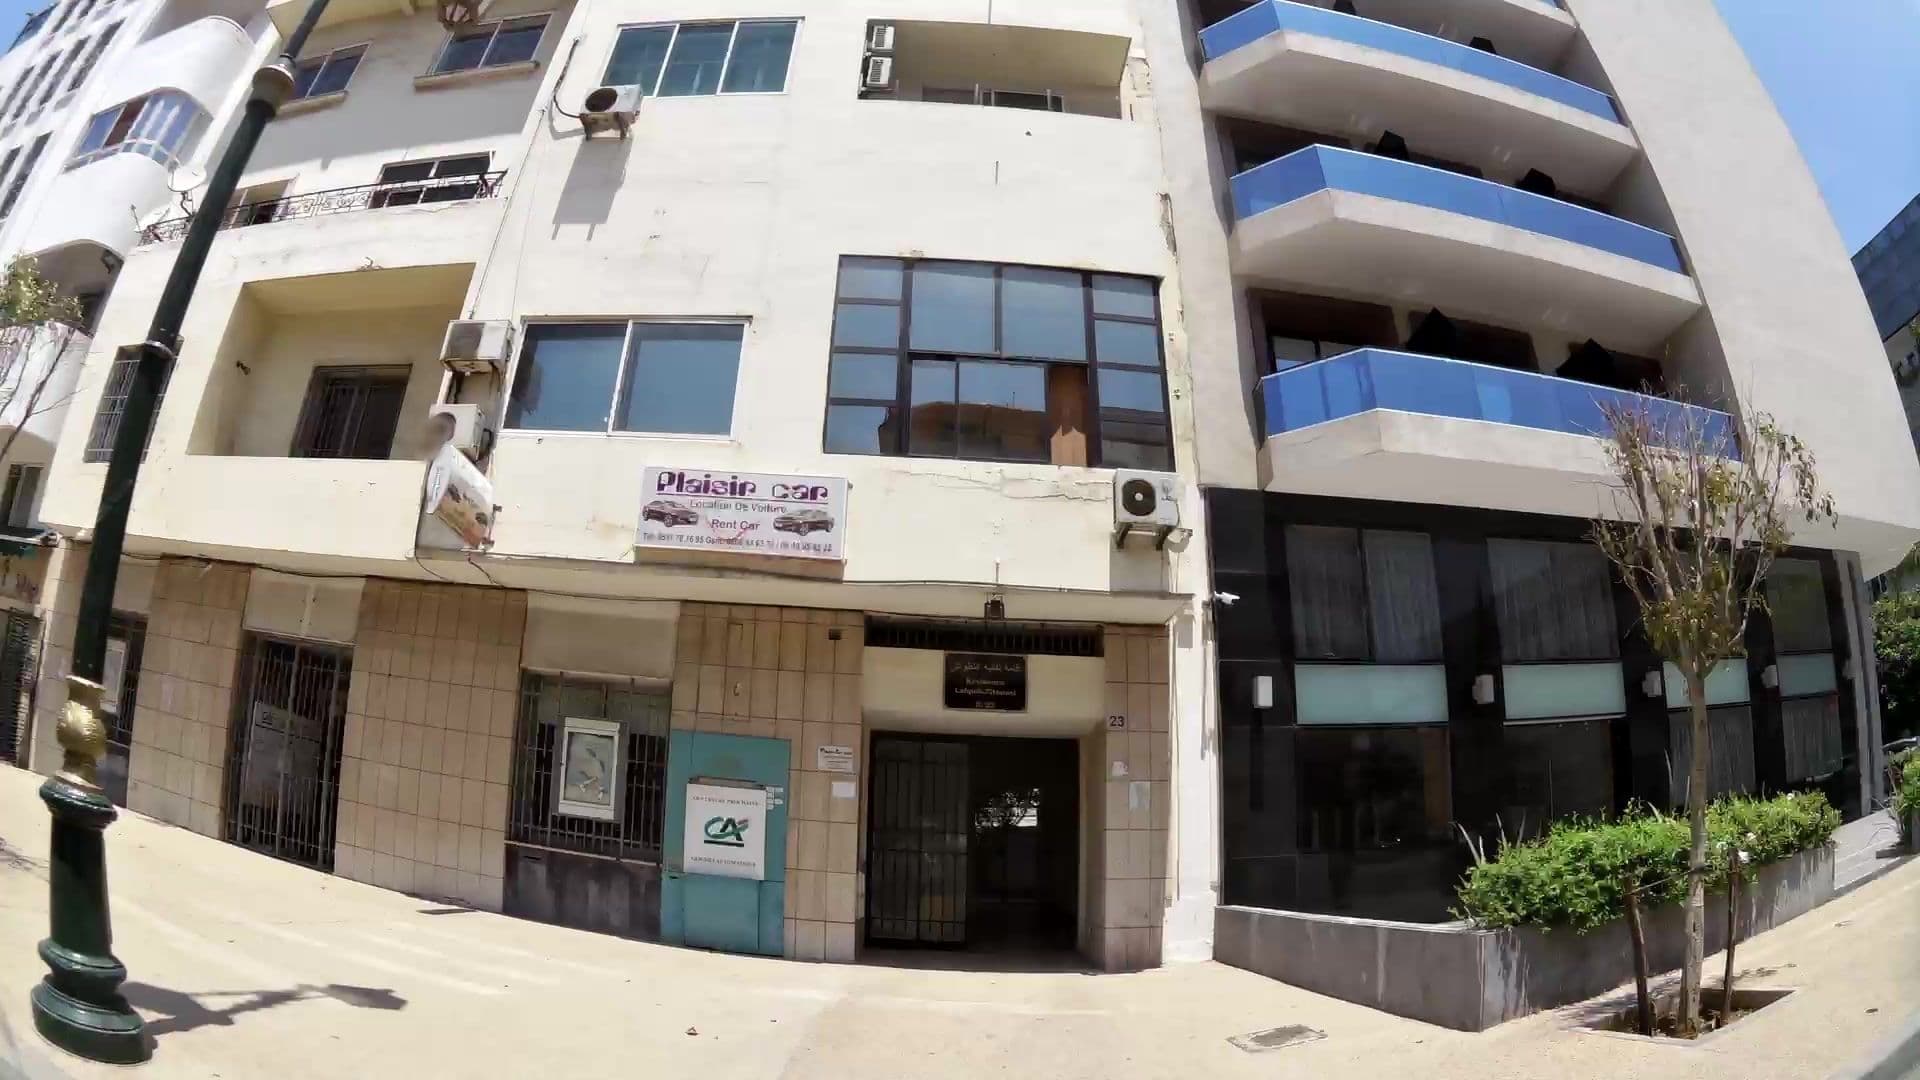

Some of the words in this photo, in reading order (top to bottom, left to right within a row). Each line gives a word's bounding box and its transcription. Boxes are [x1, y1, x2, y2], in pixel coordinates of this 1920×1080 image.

[656, 471, 757, 497] Plaisir
[772, 483, 829, 501] car
[690, 499, 732, 511] Location
[711, 518, 737, 531] Rent
[739, 520, 761, 532] Car
[1109, 715, 1125, 727] 23
